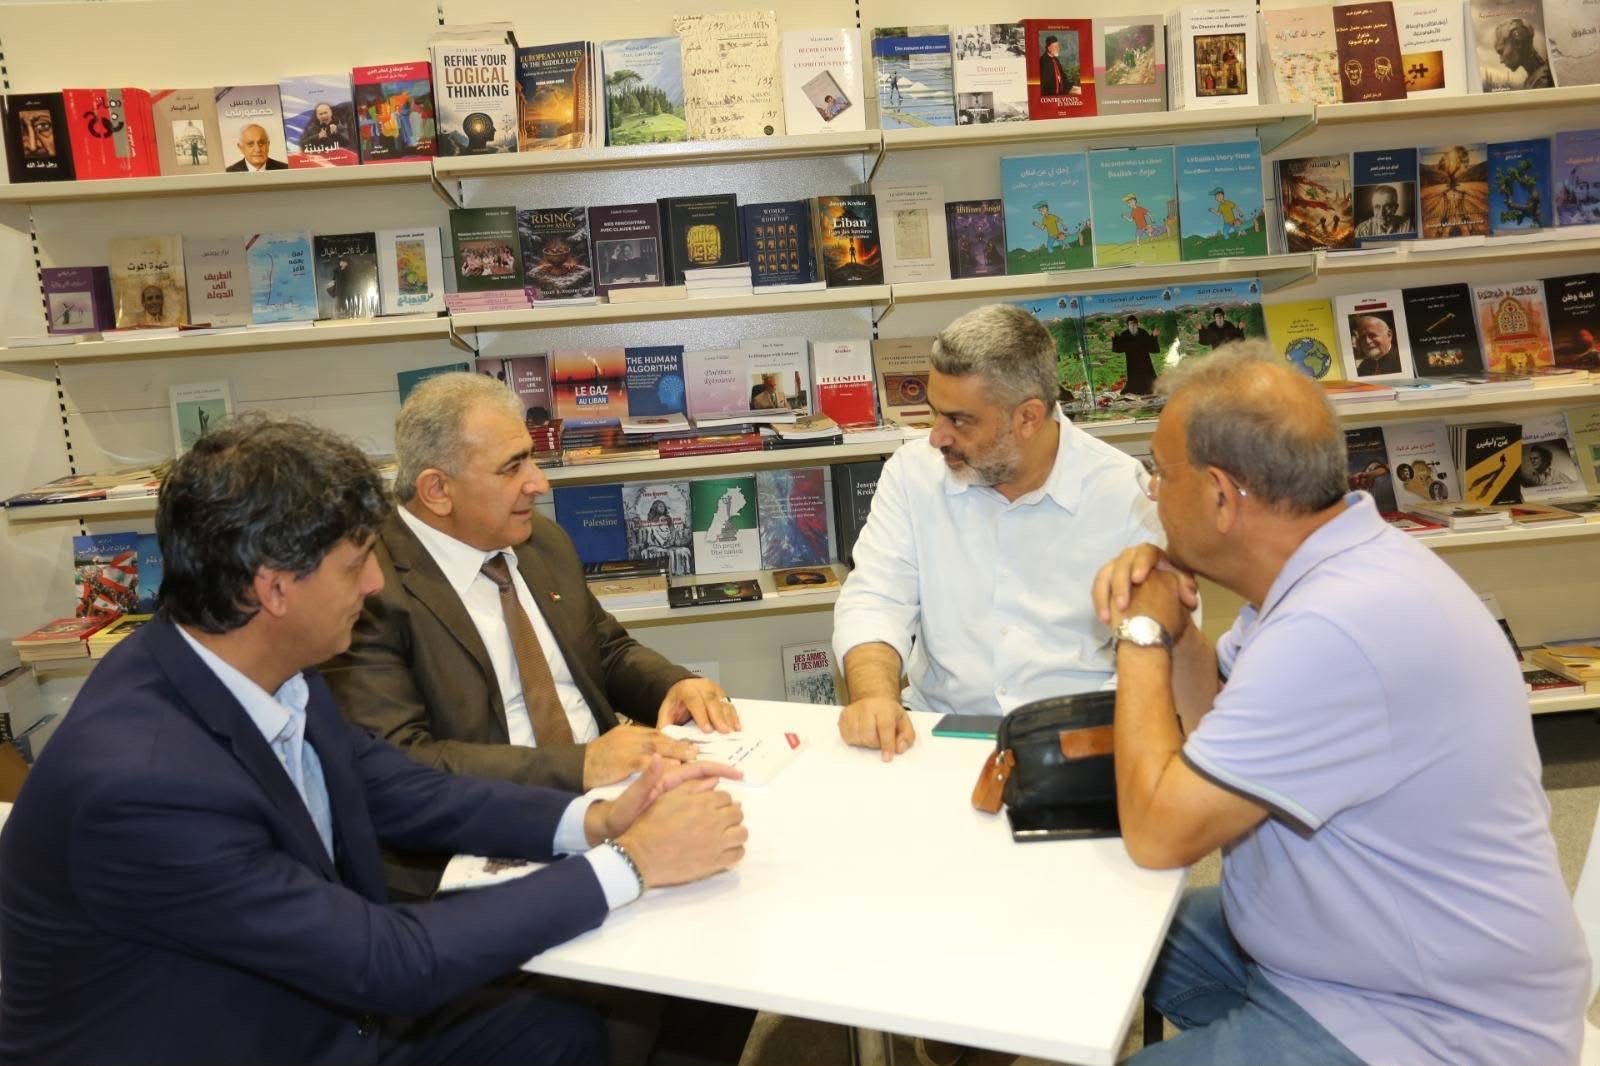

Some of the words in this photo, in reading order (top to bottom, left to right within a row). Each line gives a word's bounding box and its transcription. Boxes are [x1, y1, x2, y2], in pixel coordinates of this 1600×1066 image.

[444, 54, 477, 67] REFINE
[480, 54, 507, 66] YOUR
[520, 52, 556, 62] EUROPEAN
[557, 49, 582, 58] VALUES
[542, 59, 564, 67] MIDDLE
[445, 66, 510, 85] LOGICAL
[446, 84, 510, 99] THINKING
[531, 213, 573, 224] RISING
[833, 217, 867, 229] Liban
[626, 356, 643, 365] THE
[644, 355, 677, 364] HUMAN
[627, 364, 678, 374] ALGORITHM
[575, 386, 587, 397] LE
[589, 385, 608, 396] GAZ
[588, 397, 607, 405] LIBAN
[583, 518, 618, 528] Palestine
[794, 654, 806, 664] DES
[807, 651, 827, 662] ARMES
[793, 662, 801, 672] ET
[801, 661, 813, 670] DES
[813, 659, 829, 669] MOTS
